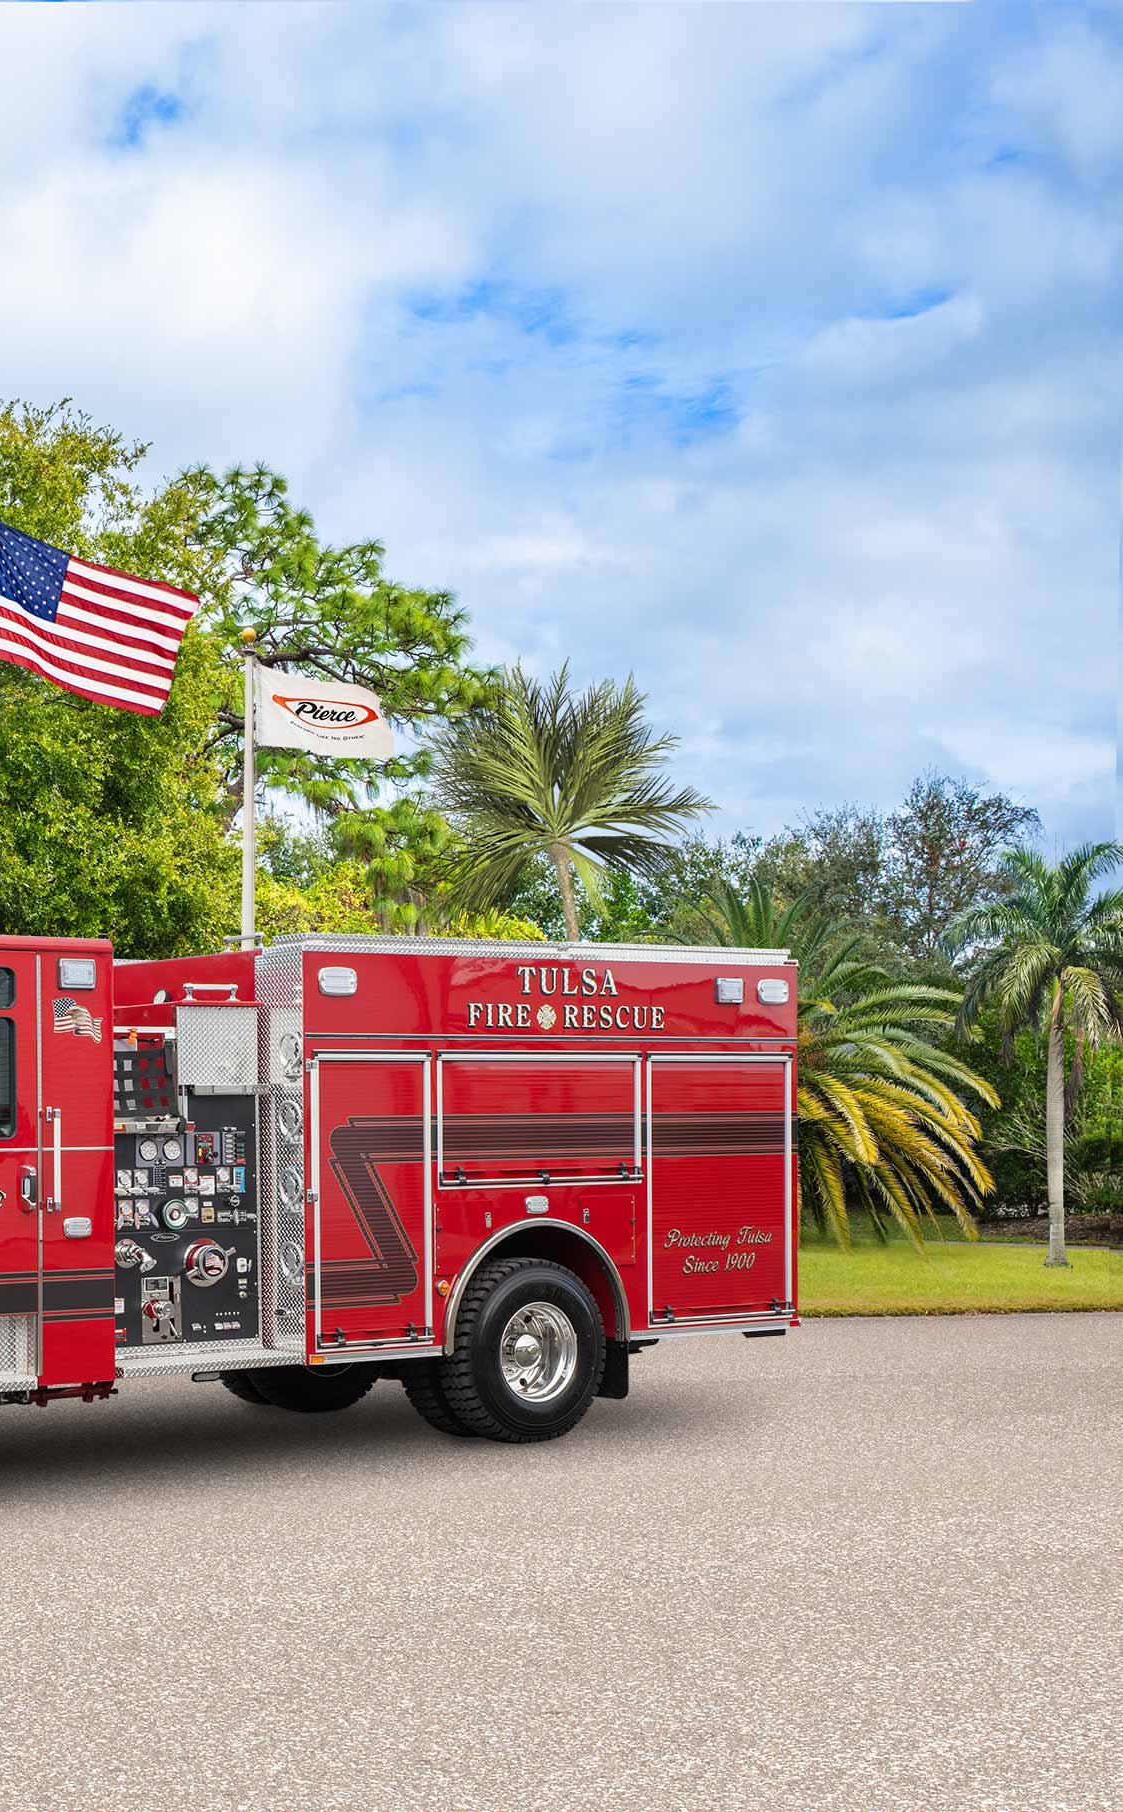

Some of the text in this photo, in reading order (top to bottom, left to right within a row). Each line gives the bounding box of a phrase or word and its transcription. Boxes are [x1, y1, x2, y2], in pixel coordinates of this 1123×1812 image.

[295, 701, 356, 722] Pierce
[517, 966, 619, 996] TULSA
[467, 1003, 665, 1030] FIRE RESCUE
[663, 1225, 773, 1251] Protecting Tulsa
[682, 1251, 757, 1275] Since 1900
